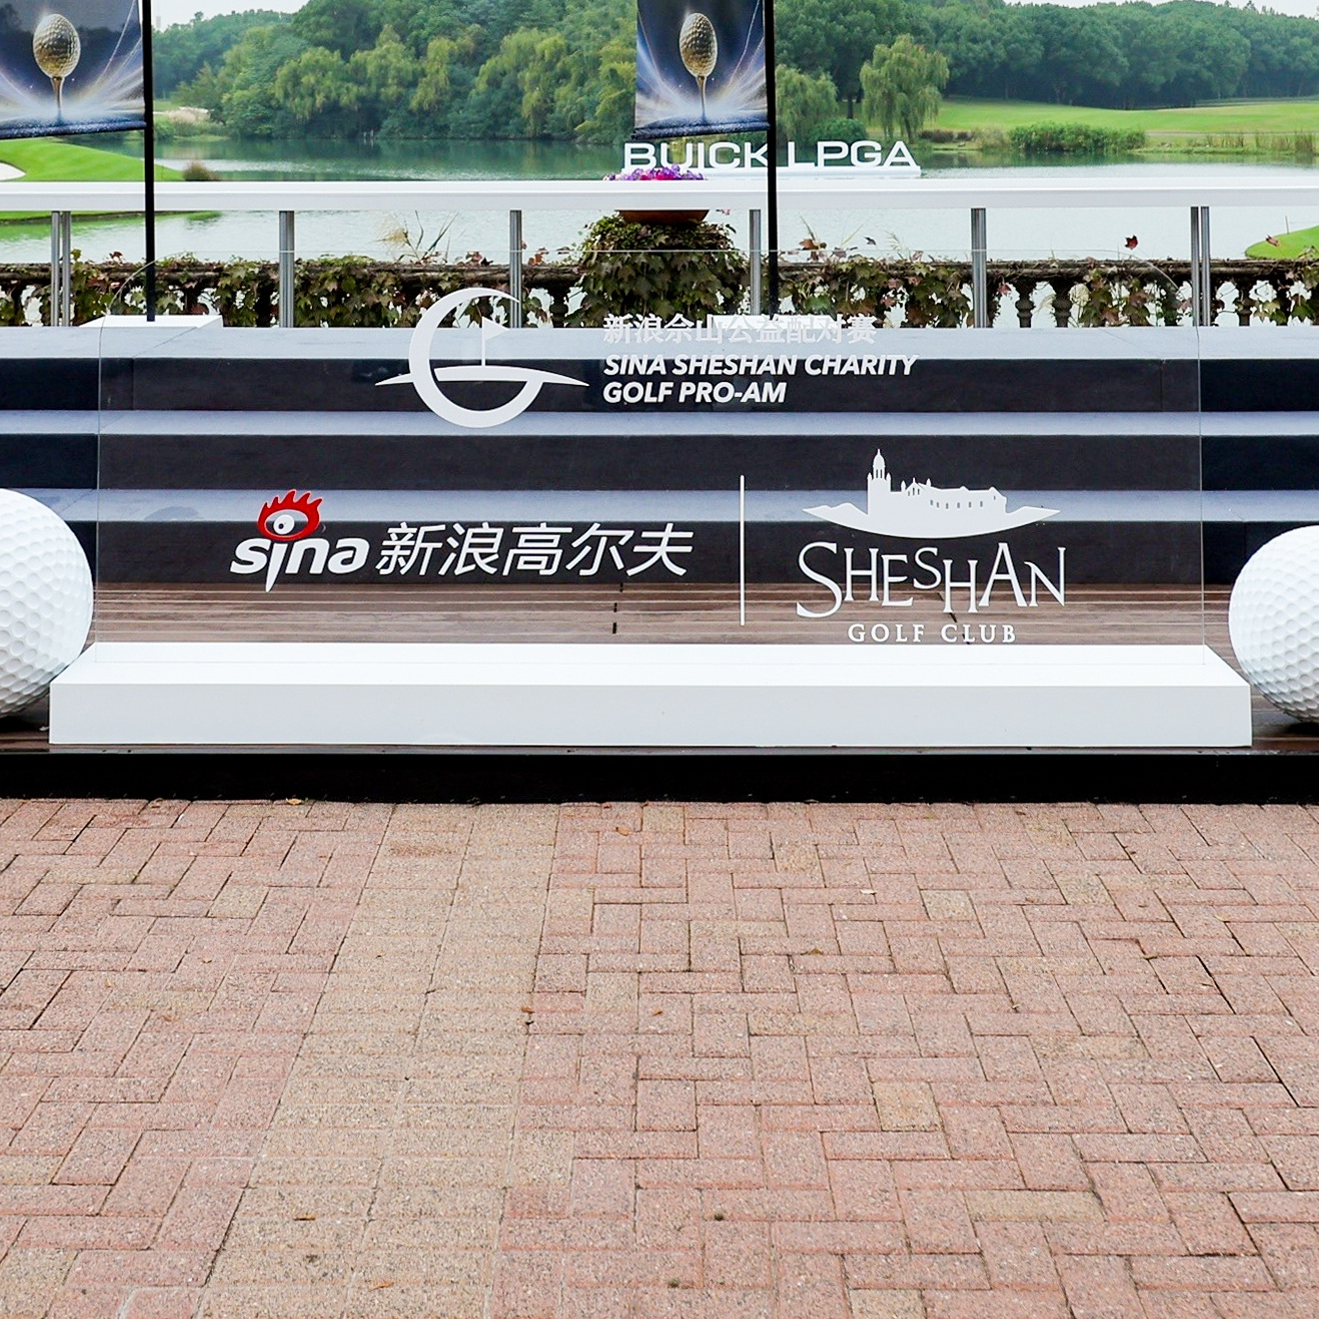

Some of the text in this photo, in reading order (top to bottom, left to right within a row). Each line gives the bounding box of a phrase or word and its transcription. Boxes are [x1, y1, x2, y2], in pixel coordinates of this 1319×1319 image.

[624, 140, 920, 169] BUICK LPGA
[603, 313, 878, 345] 新浪佘山公益配对赛
[603, 354, 918, 376] SINA SHESHAN CHARITY
[603, 381, 787, 404] GOLF PRO-AM
[230, 514, 695, 592] sina 新浪高尔夫
[796, 541, 1067, 619] SHESHAN
[847, 622, 1018, 644] GOLF CLUB
